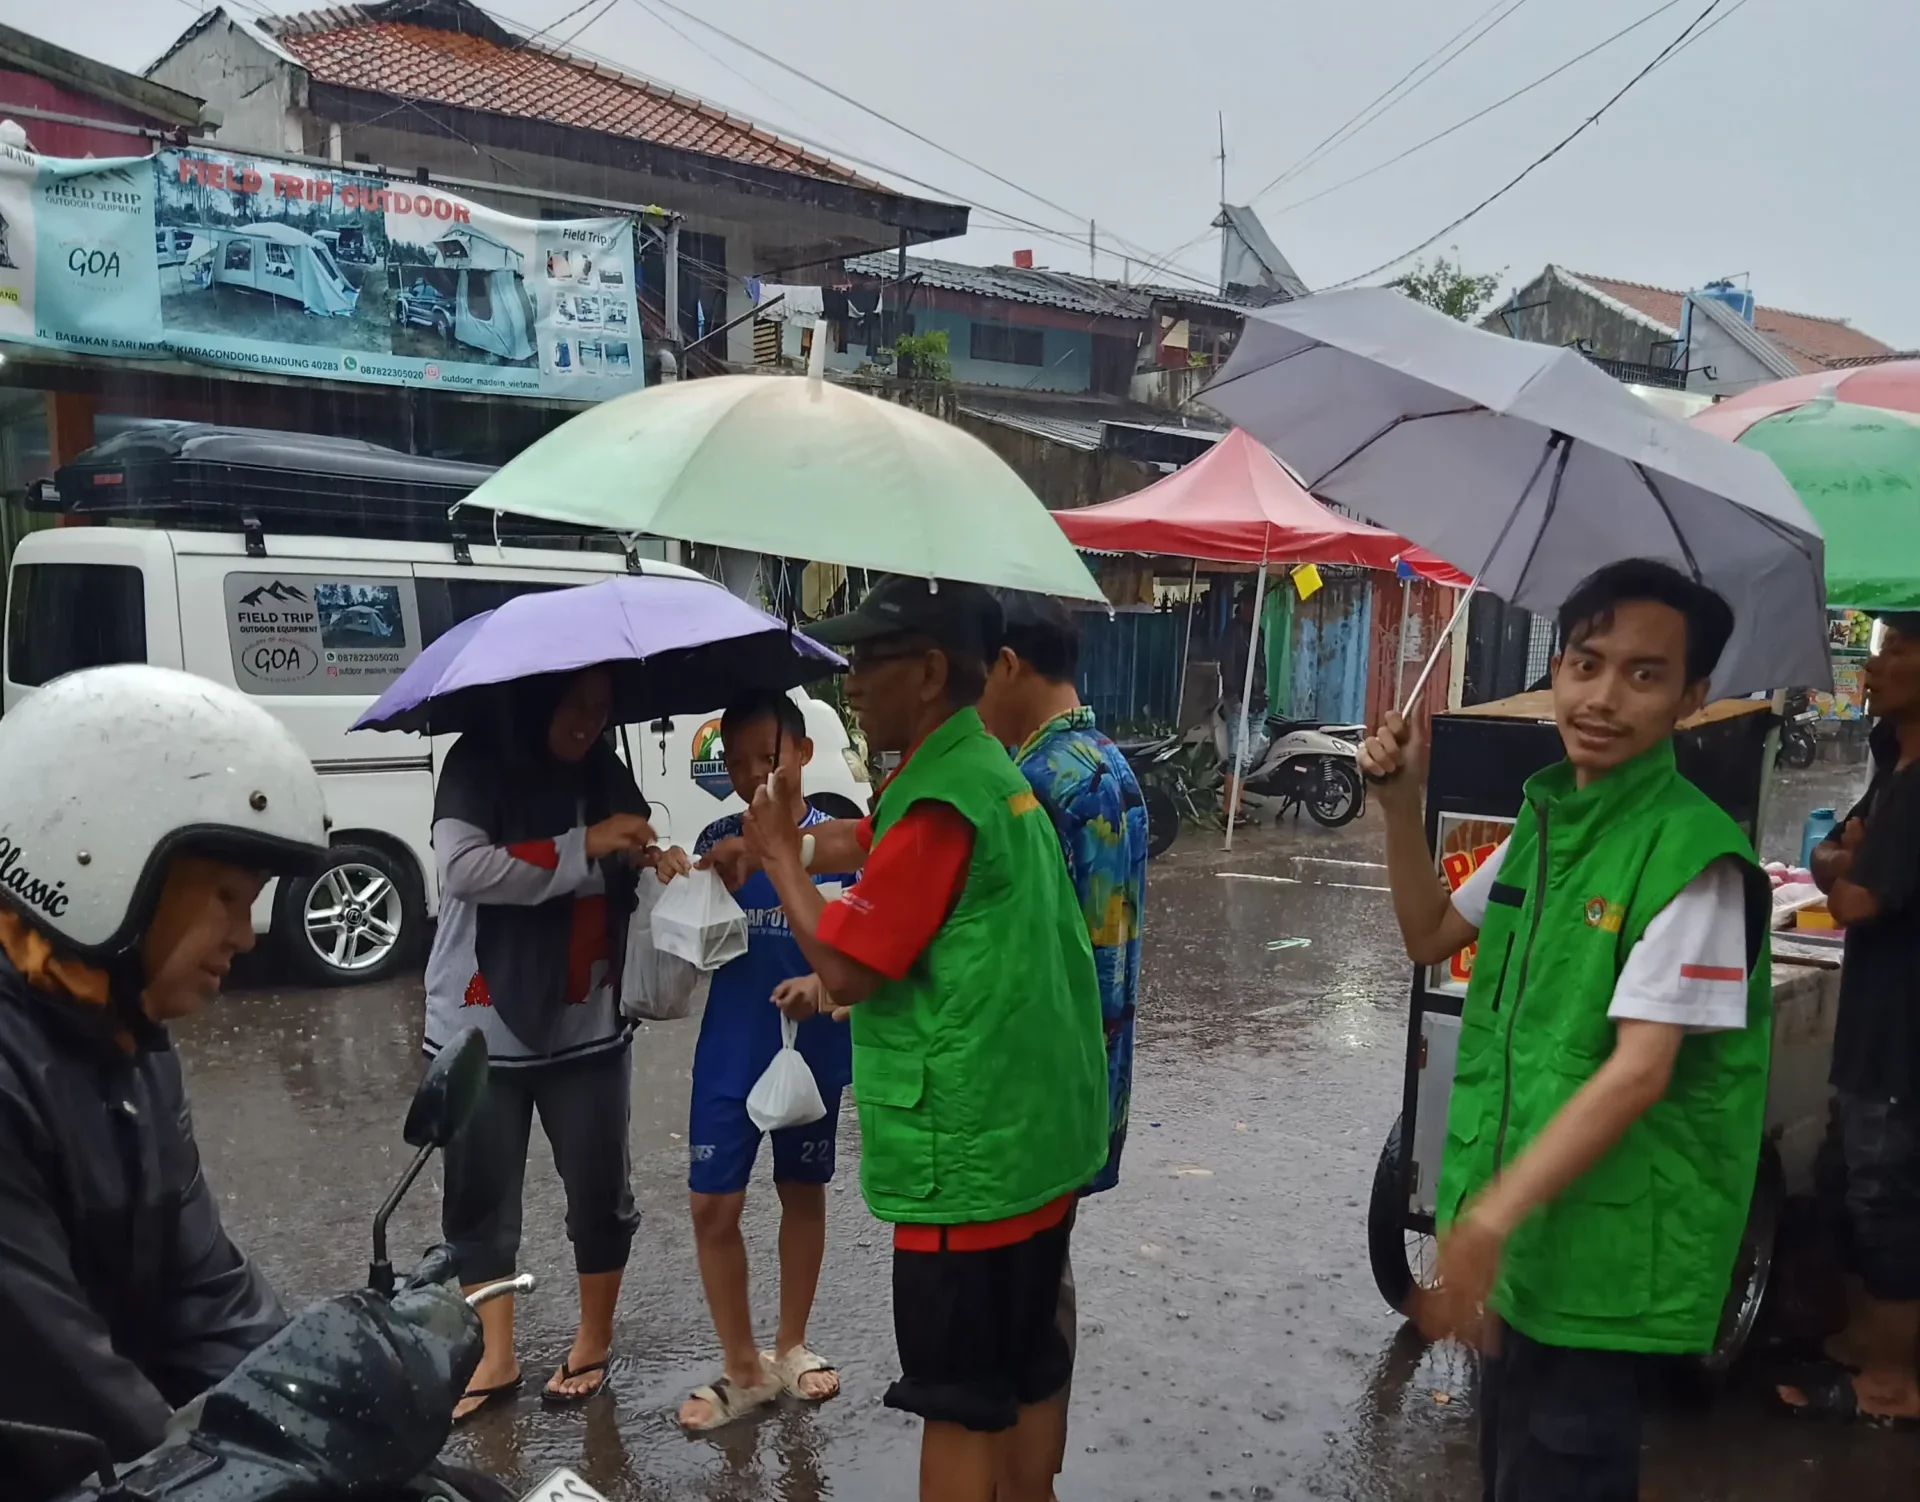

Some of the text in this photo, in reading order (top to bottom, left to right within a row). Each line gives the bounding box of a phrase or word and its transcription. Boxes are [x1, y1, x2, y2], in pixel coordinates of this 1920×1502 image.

[45, 184, 141, 204] FIELD TRIP
[179, 158, 470, 224] FIELD TRIP OUTDOOR
[46, 195, 141, 214] OUTDOOR EQUIPMENT
[563, 228, 607, 246] Field Trip
[69, 247, 120, 278] GOA
[36, 329, 51, 340] JL.
[55, 331, 109, 348] BABAKAN
[112, 340, 136, 350] SARI
[177, 344, 259, 363] KIARACONDONG
[261, 355, 309, 368] BANDUNG
[311, 361, 338, 371] 40283
[360, 366, 424, 380] 087822305020
[238, 612, 314, 623] FIELD TRIP
[277, 626, 318, 634] EQUIPMENT
[255, 647, 300, 673] GOA
[337, 653, 399, 662] 087822305020
[694, 763, 717, 774] GAJAH
[801, 1140, 829, 1162] 22
